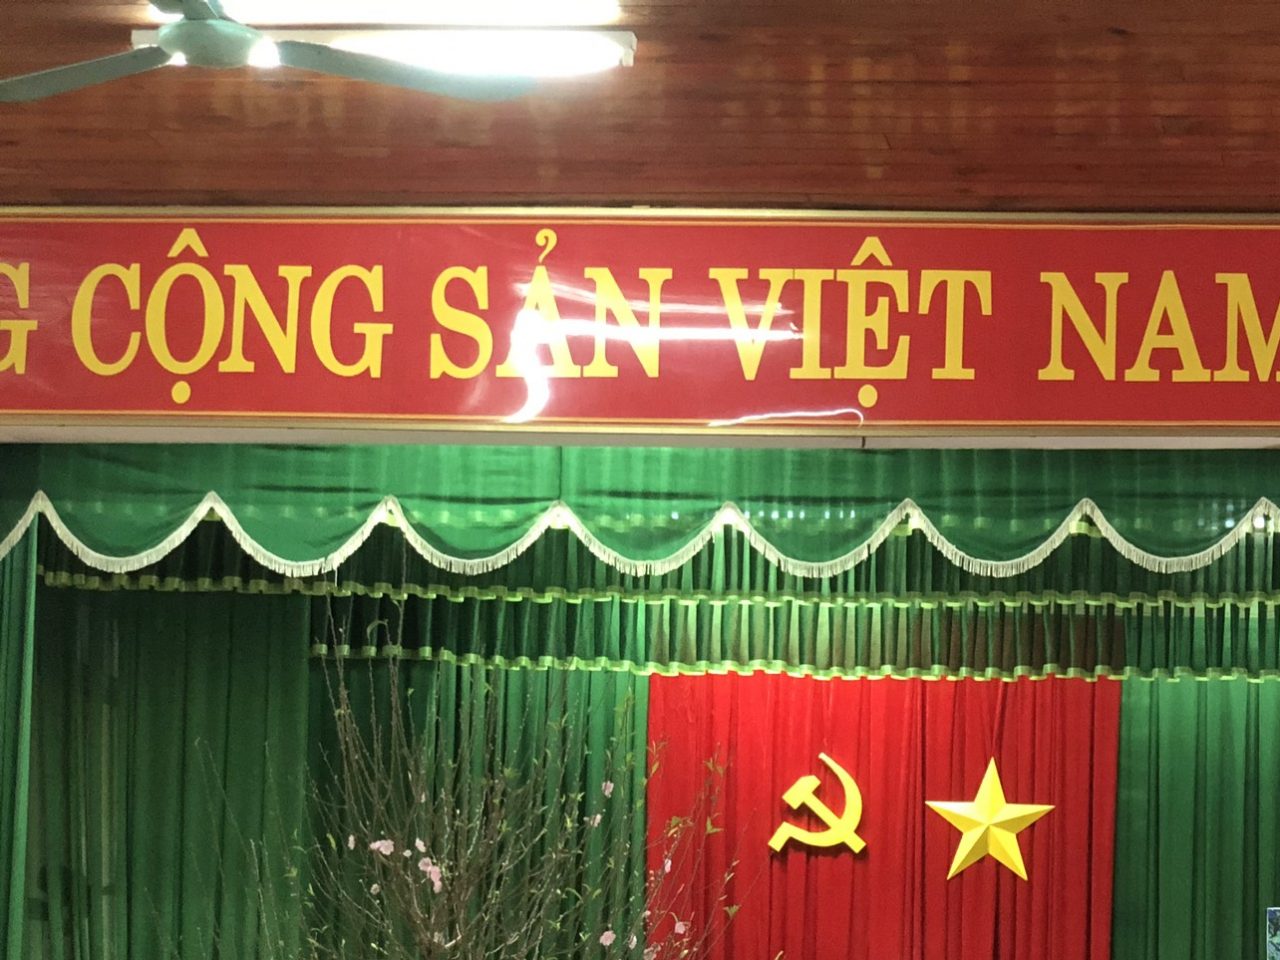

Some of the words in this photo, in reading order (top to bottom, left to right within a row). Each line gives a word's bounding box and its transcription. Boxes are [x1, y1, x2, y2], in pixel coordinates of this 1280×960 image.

[72, 229, 393, 404] CỘNG
[430, 229, 668, 380] SẢN
[709, 236, 992, 407] VIỆT
